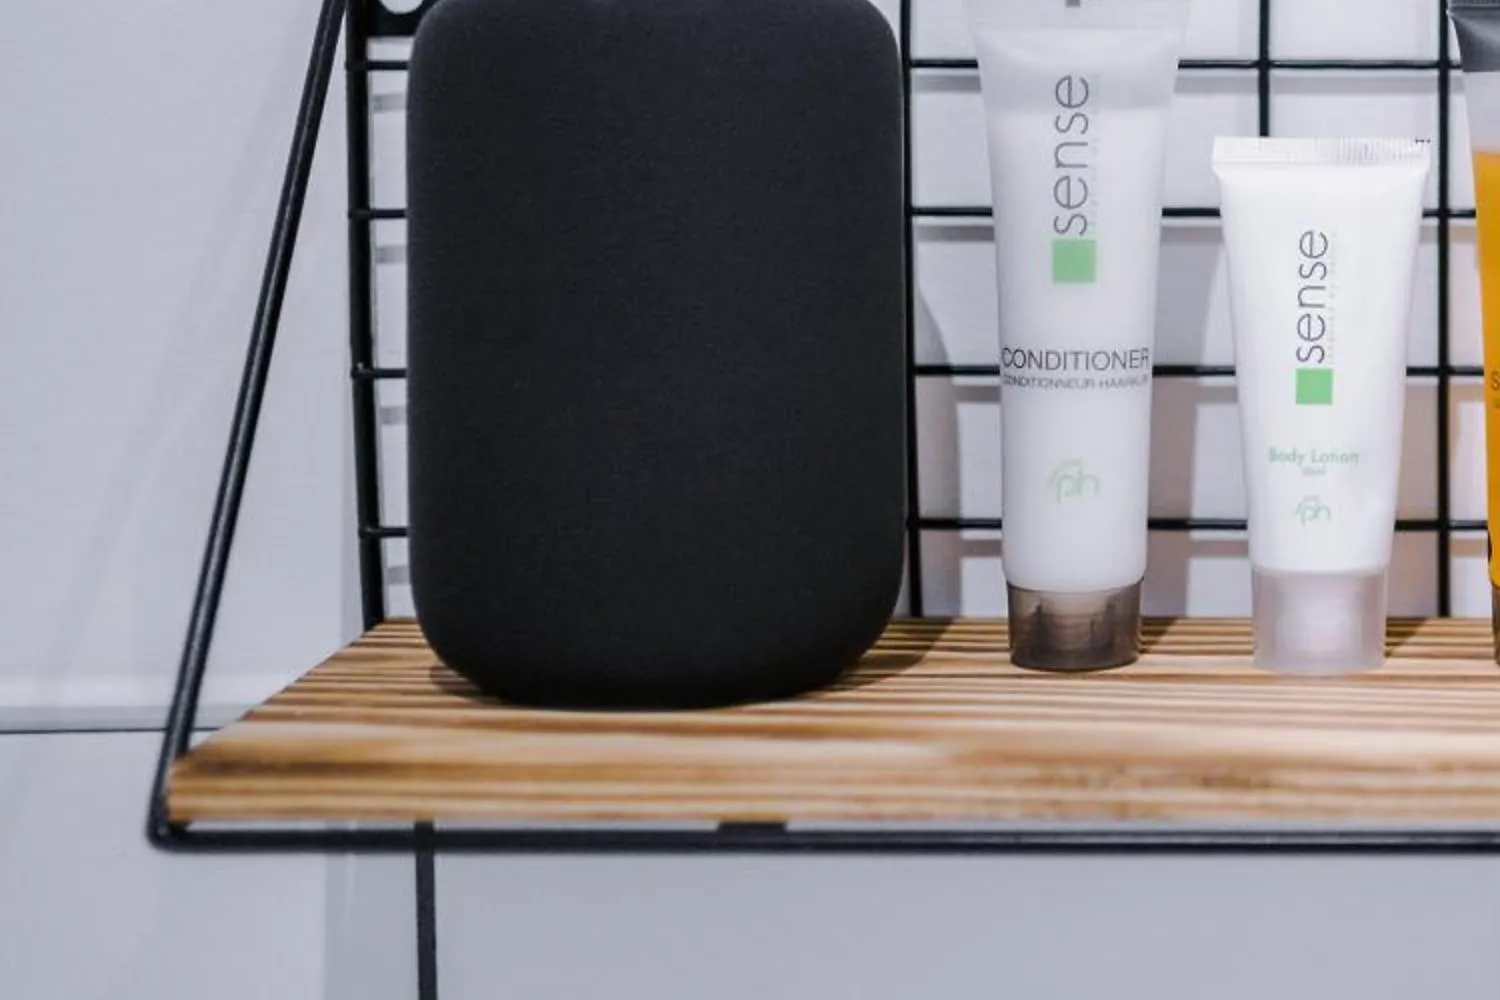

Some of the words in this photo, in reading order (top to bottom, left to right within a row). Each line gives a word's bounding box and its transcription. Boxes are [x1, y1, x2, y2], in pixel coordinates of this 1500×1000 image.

[1054, 73, 1090, 237] sense
[1001, 347, 1149, 371] CONDITIONER
[1296, 229, 1329, 365] sense
